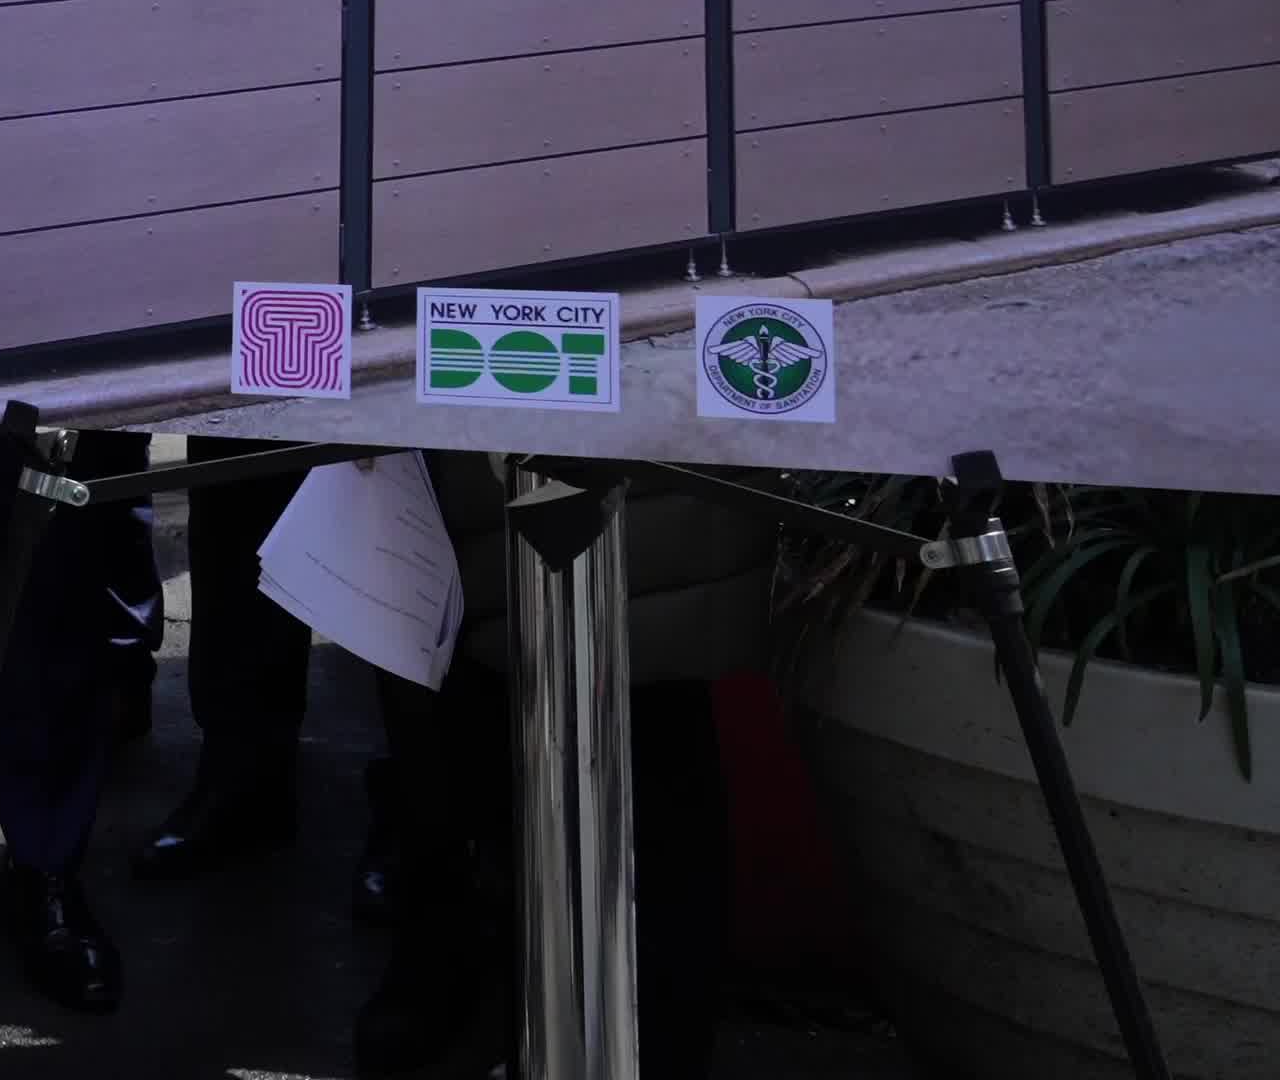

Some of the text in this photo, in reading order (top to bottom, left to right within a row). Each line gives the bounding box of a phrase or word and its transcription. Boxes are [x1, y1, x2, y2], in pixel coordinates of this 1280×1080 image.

[430, 302, 605, 324] NEW YORK CITY
[723, 307, 806, 328] NEW YORK CITY
[430, 328, 605, 396] DOT
[708, 364, 758, 409] DEPARTMENT
[775, 368, 822, 409] SANITATION
